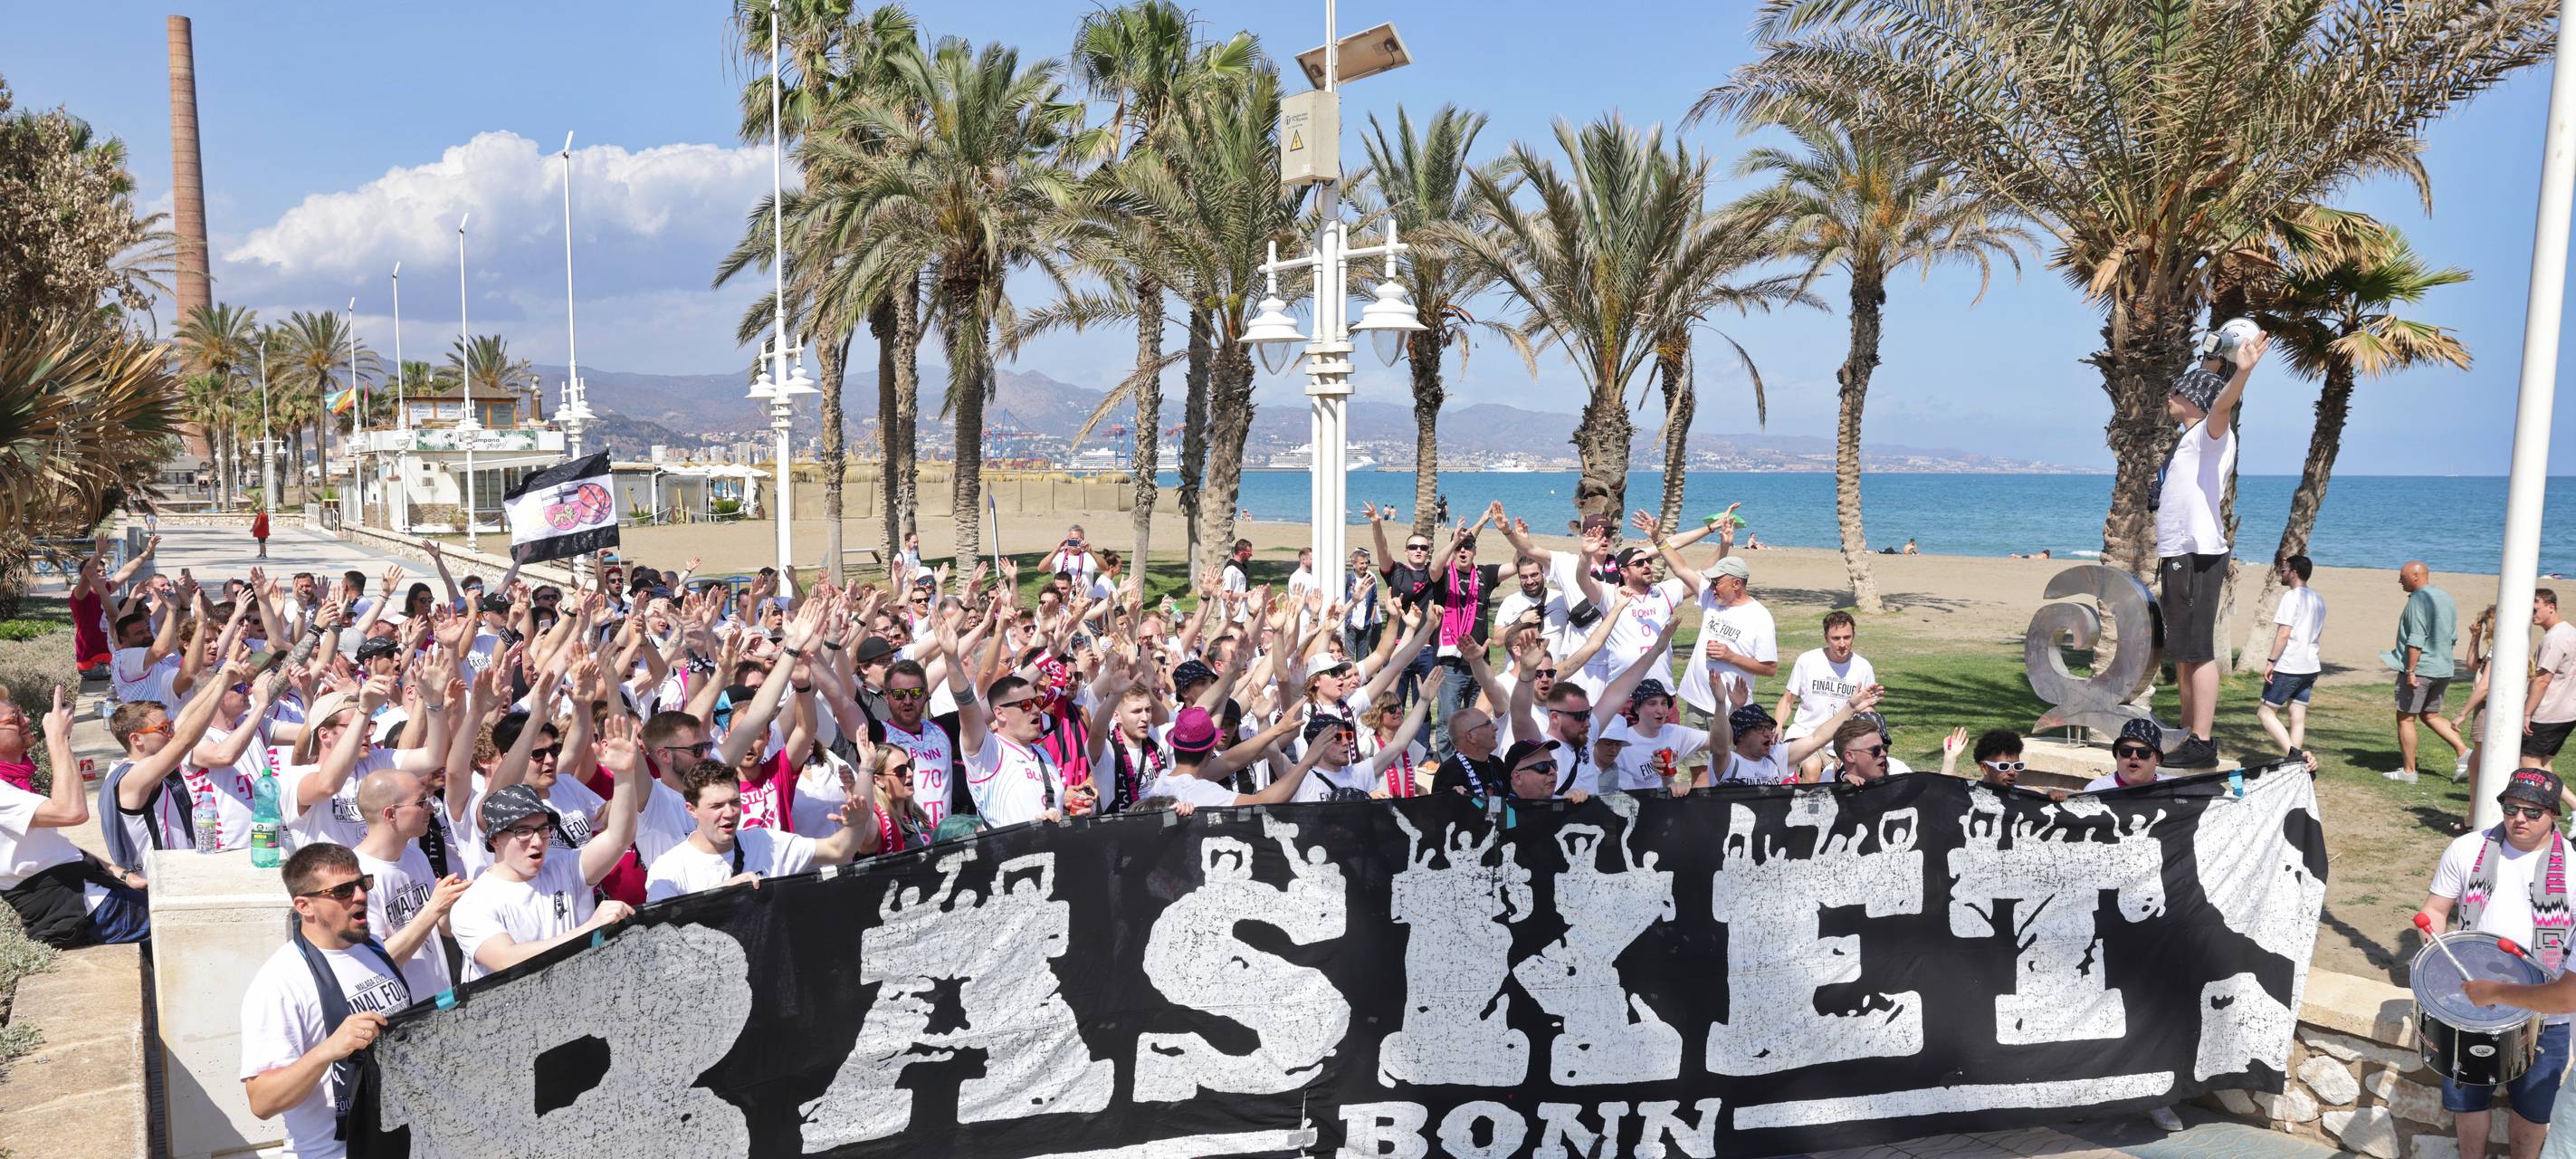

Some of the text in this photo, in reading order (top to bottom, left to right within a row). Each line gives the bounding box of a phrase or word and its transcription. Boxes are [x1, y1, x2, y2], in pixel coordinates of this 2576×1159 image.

[1632, 607, 1656, 618] BONN
[1812, 680, 1835, 692] FINAL
[910, 747, 942, 761] BNN
[1639, 761, 1655, 776] FIN
[919, 769, 942, 789] 70
[567, 817, 590, 839] FOU
[412, 883, 431, 909] FOU
[355, 978, 376, 991] MALAGA
[380, 979, 407, 1006] FOU
[1336, 1097, 1723, 1159] BONN
